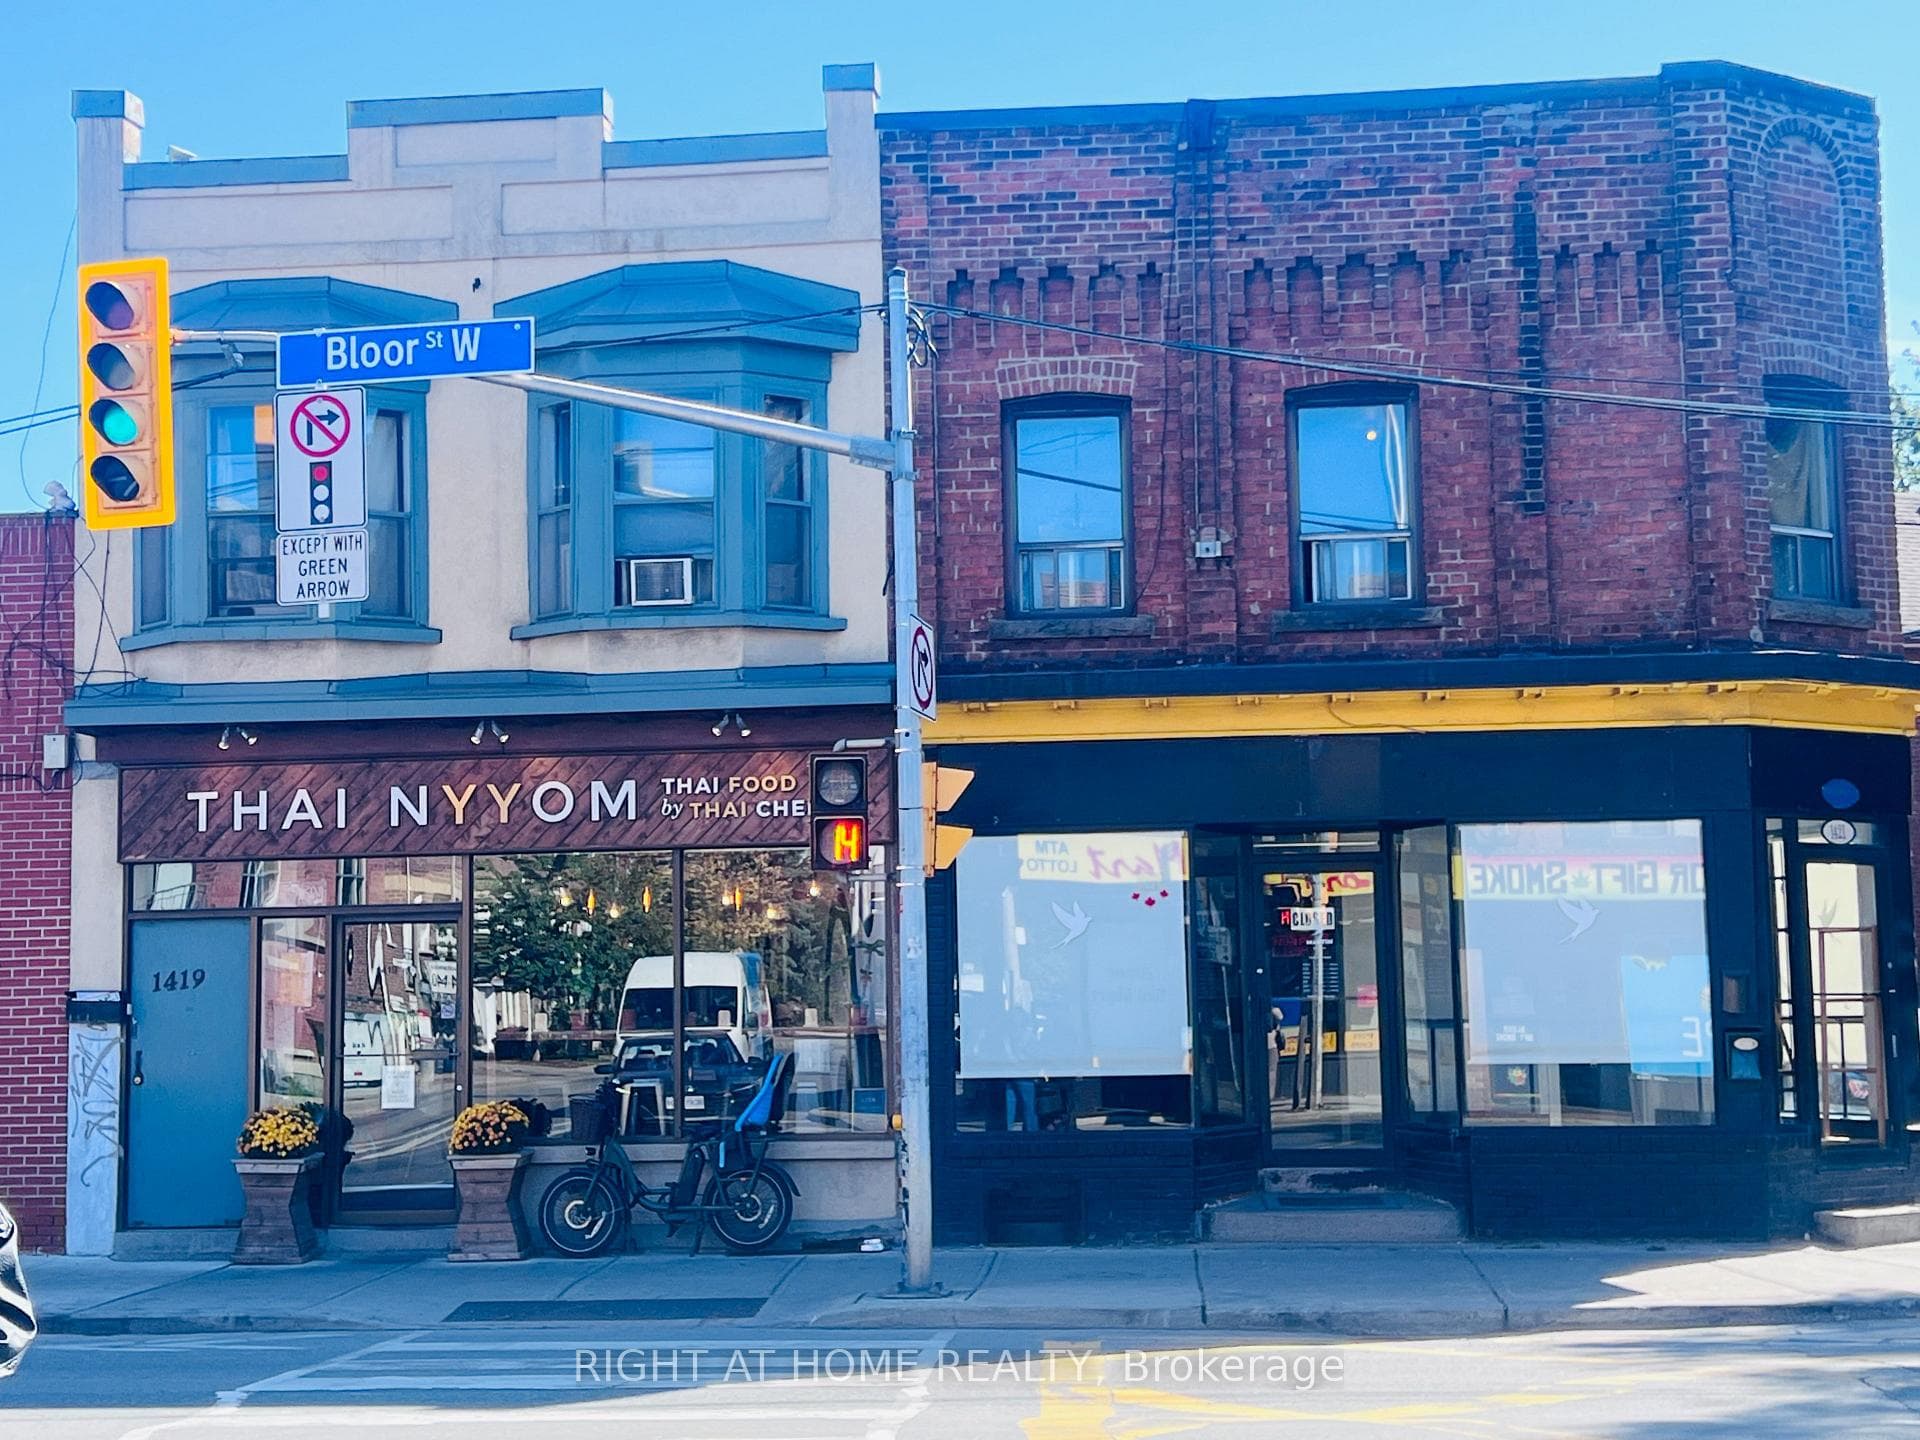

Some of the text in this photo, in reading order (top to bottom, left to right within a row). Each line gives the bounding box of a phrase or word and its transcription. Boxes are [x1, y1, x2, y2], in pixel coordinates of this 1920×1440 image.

[327, 327, 481, 370] Bloor St W
[282, 535, 362, 555] EXCEPT WITH
[298, 558, 347, 577] GREEN
[296, 580, 350, 599] ARROW
[661, 775, 797, 795] THAI FOOD
[187, 779, 637, 832] THAI NYYOM
[661, 798, 684, 820] by
[689, 801, 747, 819] THAI
[152, 968, 206, 993] 1419
